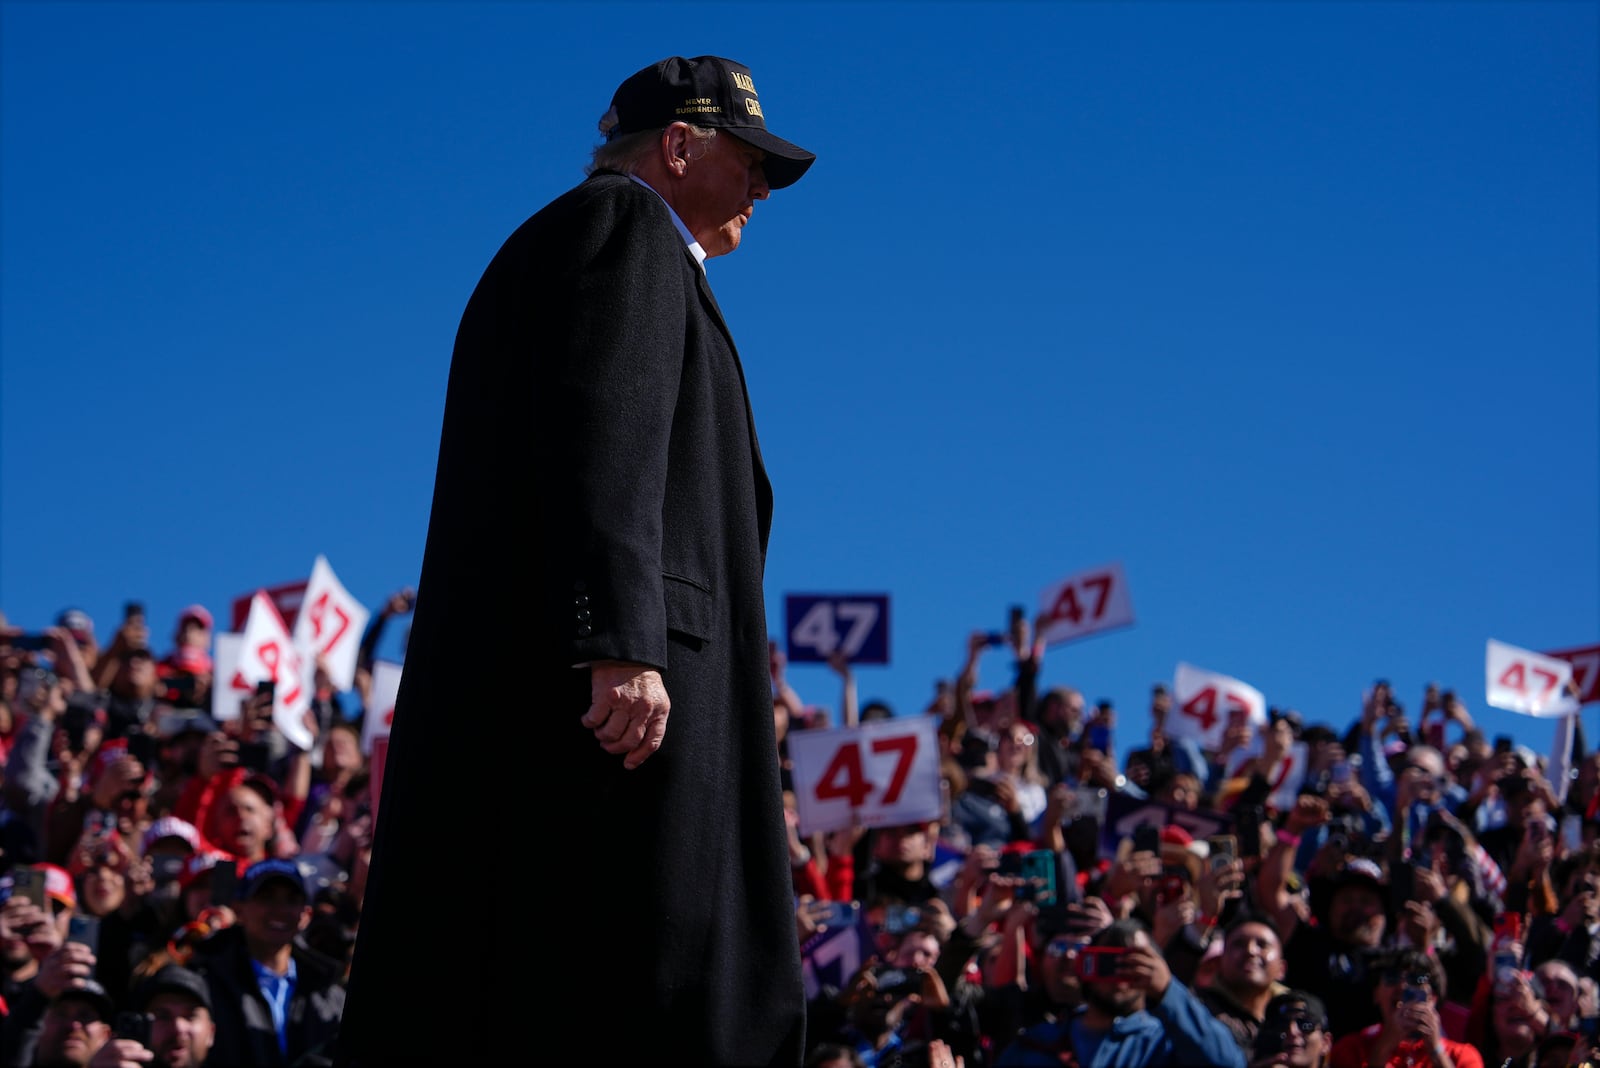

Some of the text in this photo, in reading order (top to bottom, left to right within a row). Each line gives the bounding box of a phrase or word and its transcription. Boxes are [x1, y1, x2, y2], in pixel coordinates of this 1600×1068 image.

[675, 105, 722, 114] SURRENDER
[685, 97, 712, 105] NEVER
[745, 97, 764, 120] GRE
[1050, 575, 1112, 624] 47
[791, 602, 880, 658] 47
[1499, 662, 1559, 705] 47
[1573, 655, 1600, 698] 7
[814, 734, 919, 807] 47
